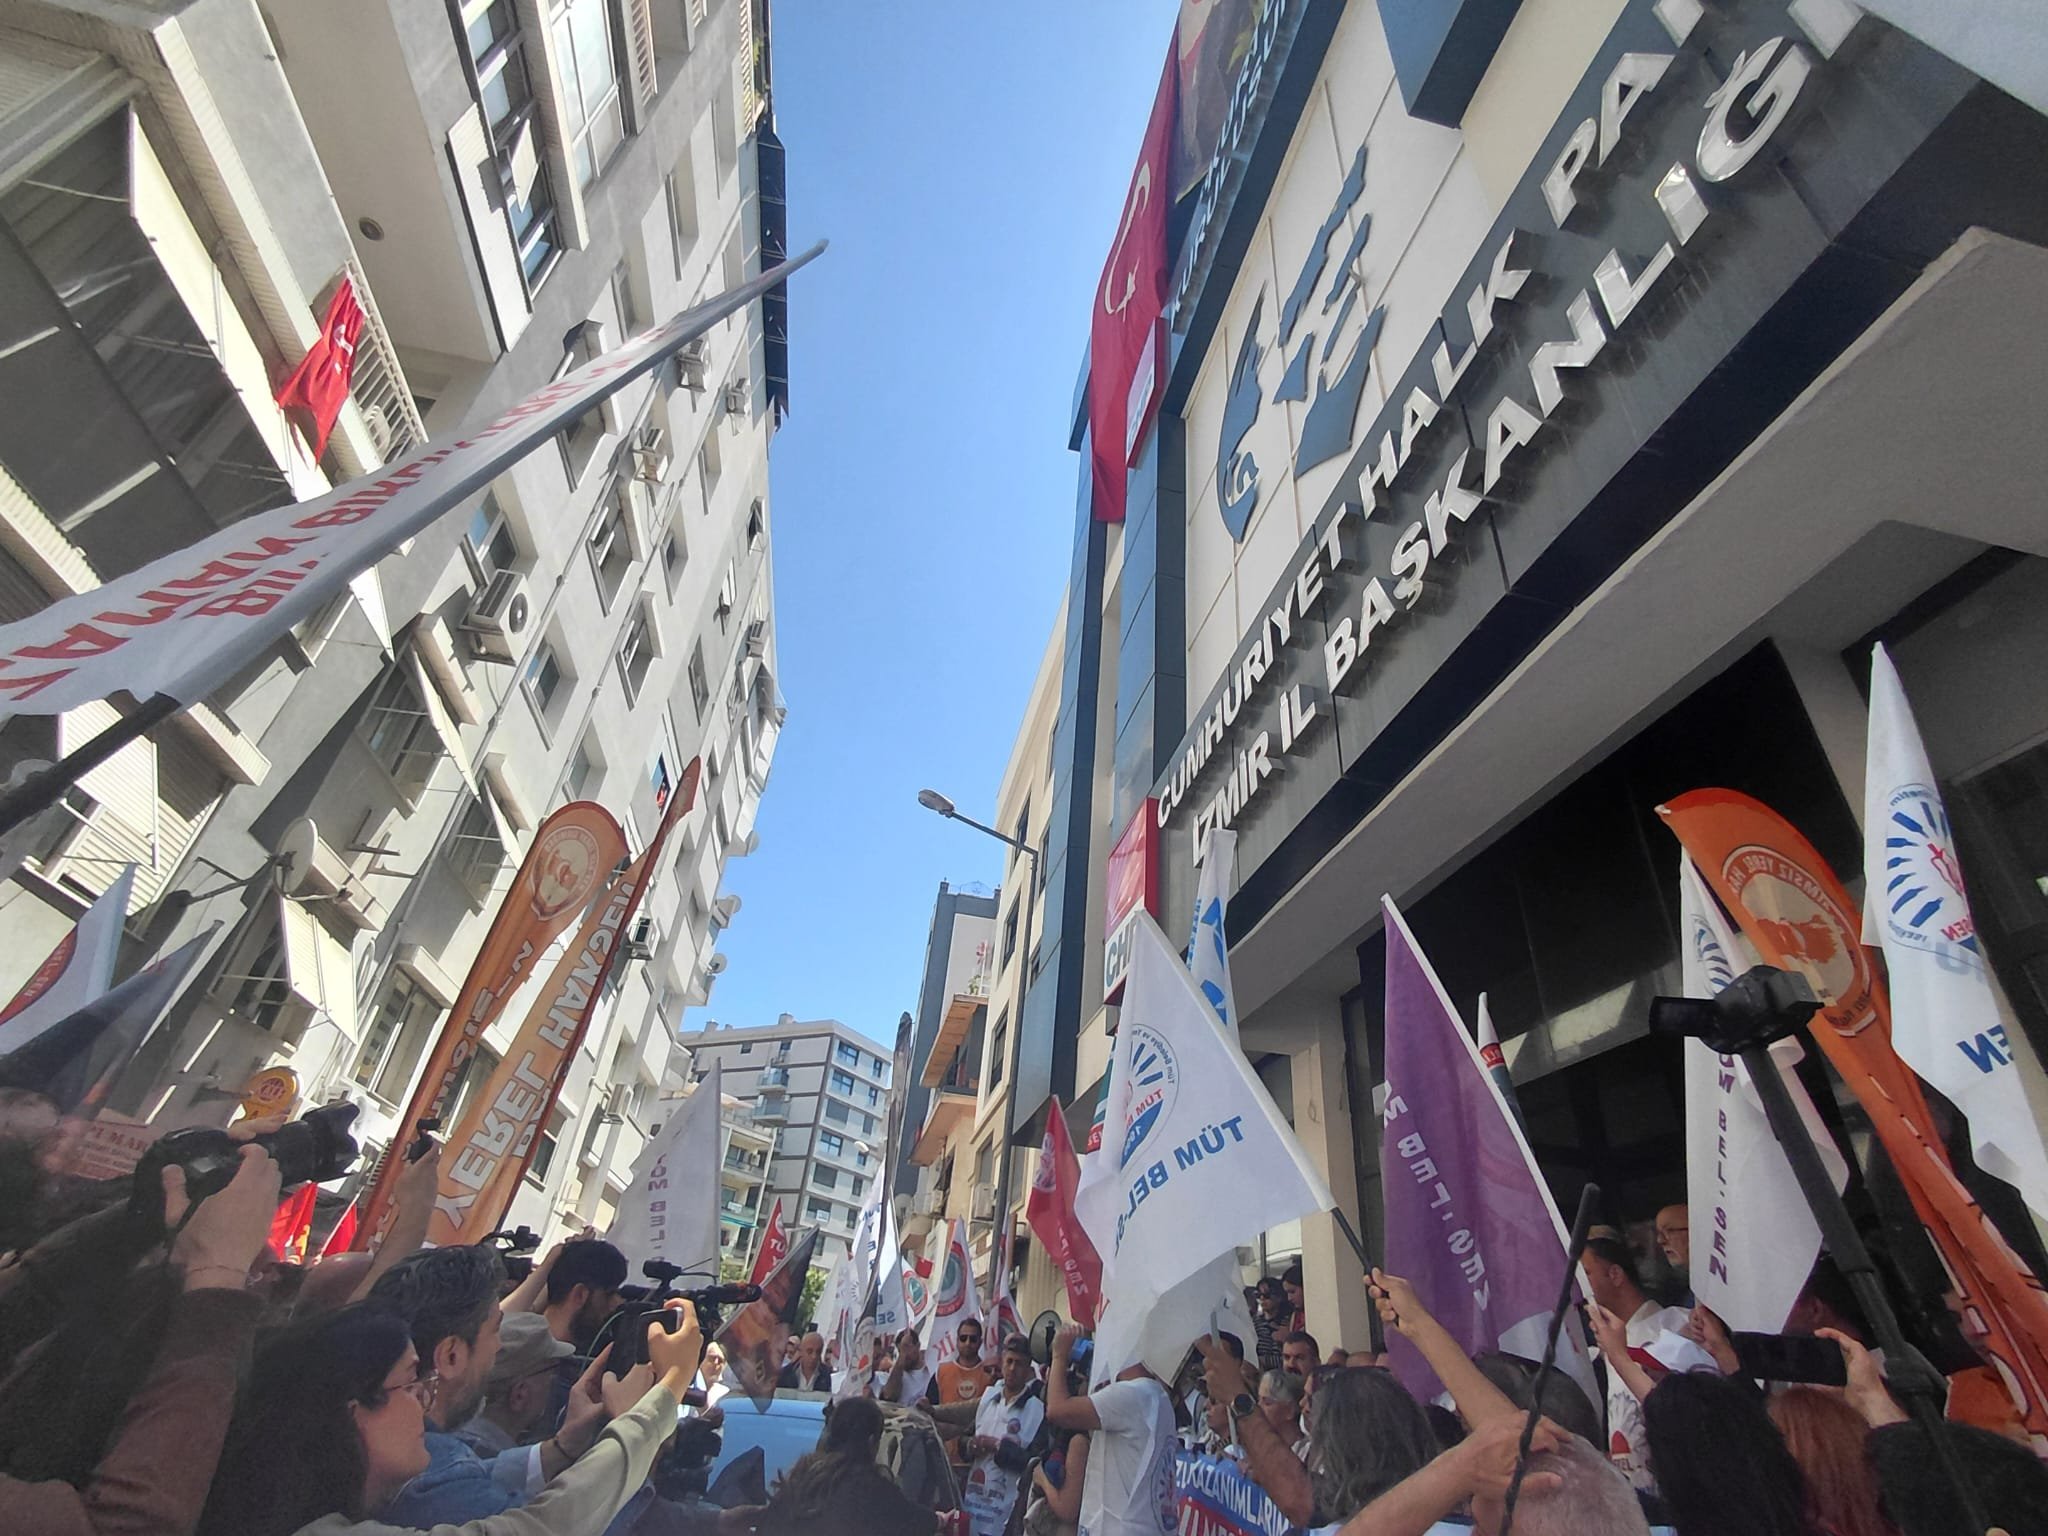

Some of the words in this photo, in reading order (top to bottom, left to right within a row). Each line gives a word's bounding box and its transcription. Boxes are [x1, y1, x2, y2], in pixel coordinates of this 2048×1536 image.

[1157, 502, 1348, 828] CUMHURİYET
[1359, 229, 1531, 519] HALK
[1193, 732, 1273, 868] İZMİR
[1279, 684, 1317, 754] İL
